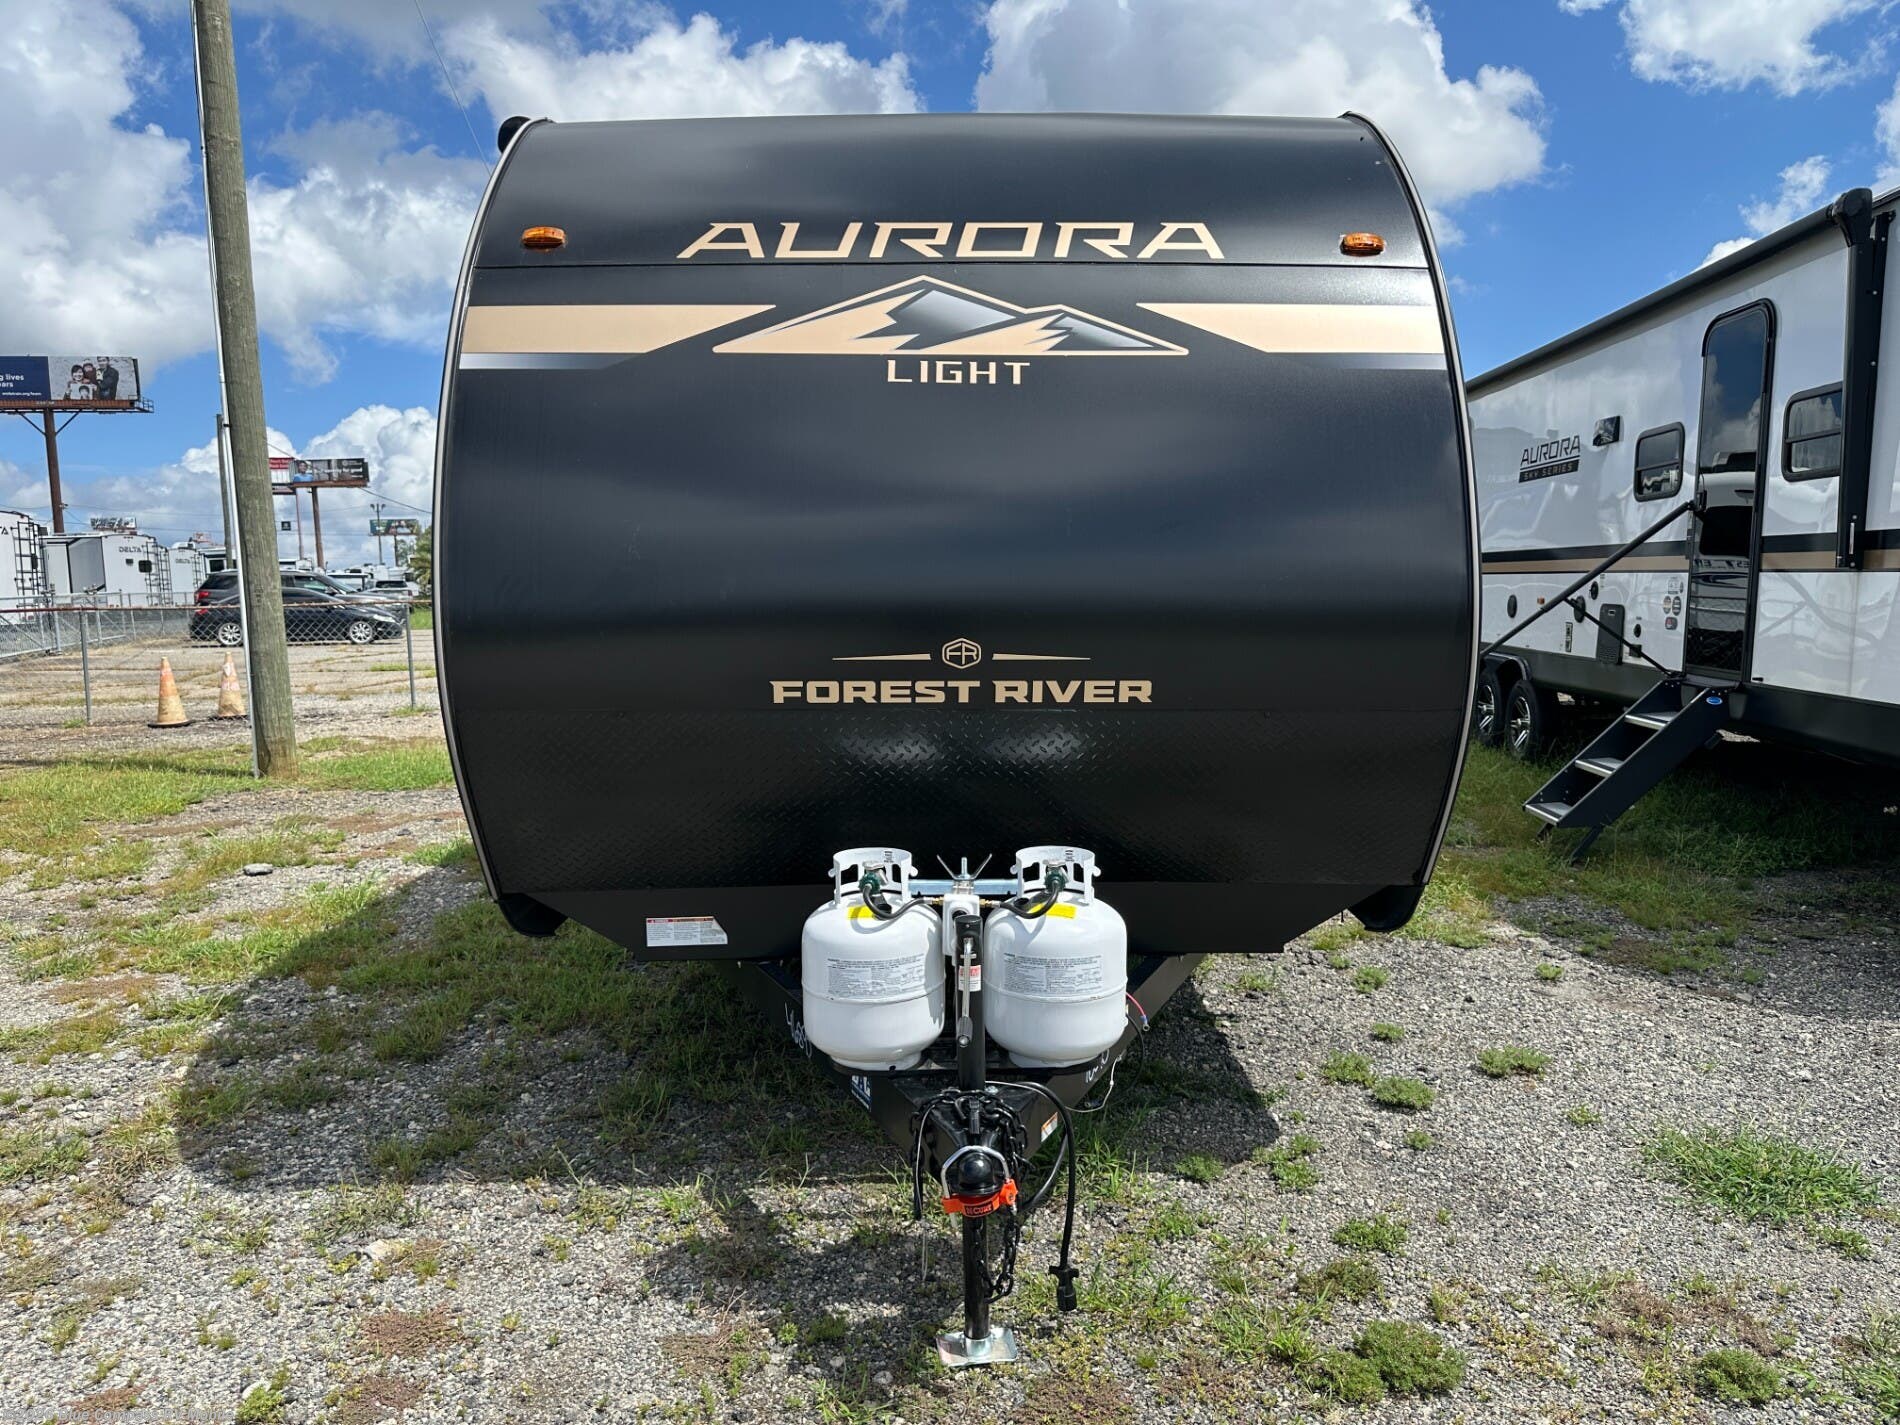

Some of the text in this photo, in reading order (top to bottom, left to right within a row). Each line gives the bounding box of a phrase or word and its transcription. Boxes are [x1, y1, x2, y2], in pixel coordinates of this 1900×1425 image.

[677, 222, 1225, 259] AURORA
[886, 359, 1031, 384] LIGHT
[1520, 435, 1580, 467] AURORA
[1541, 462, 1574, 478] SERIES
[769, 680, 1152, 703] FOREST RIVER
